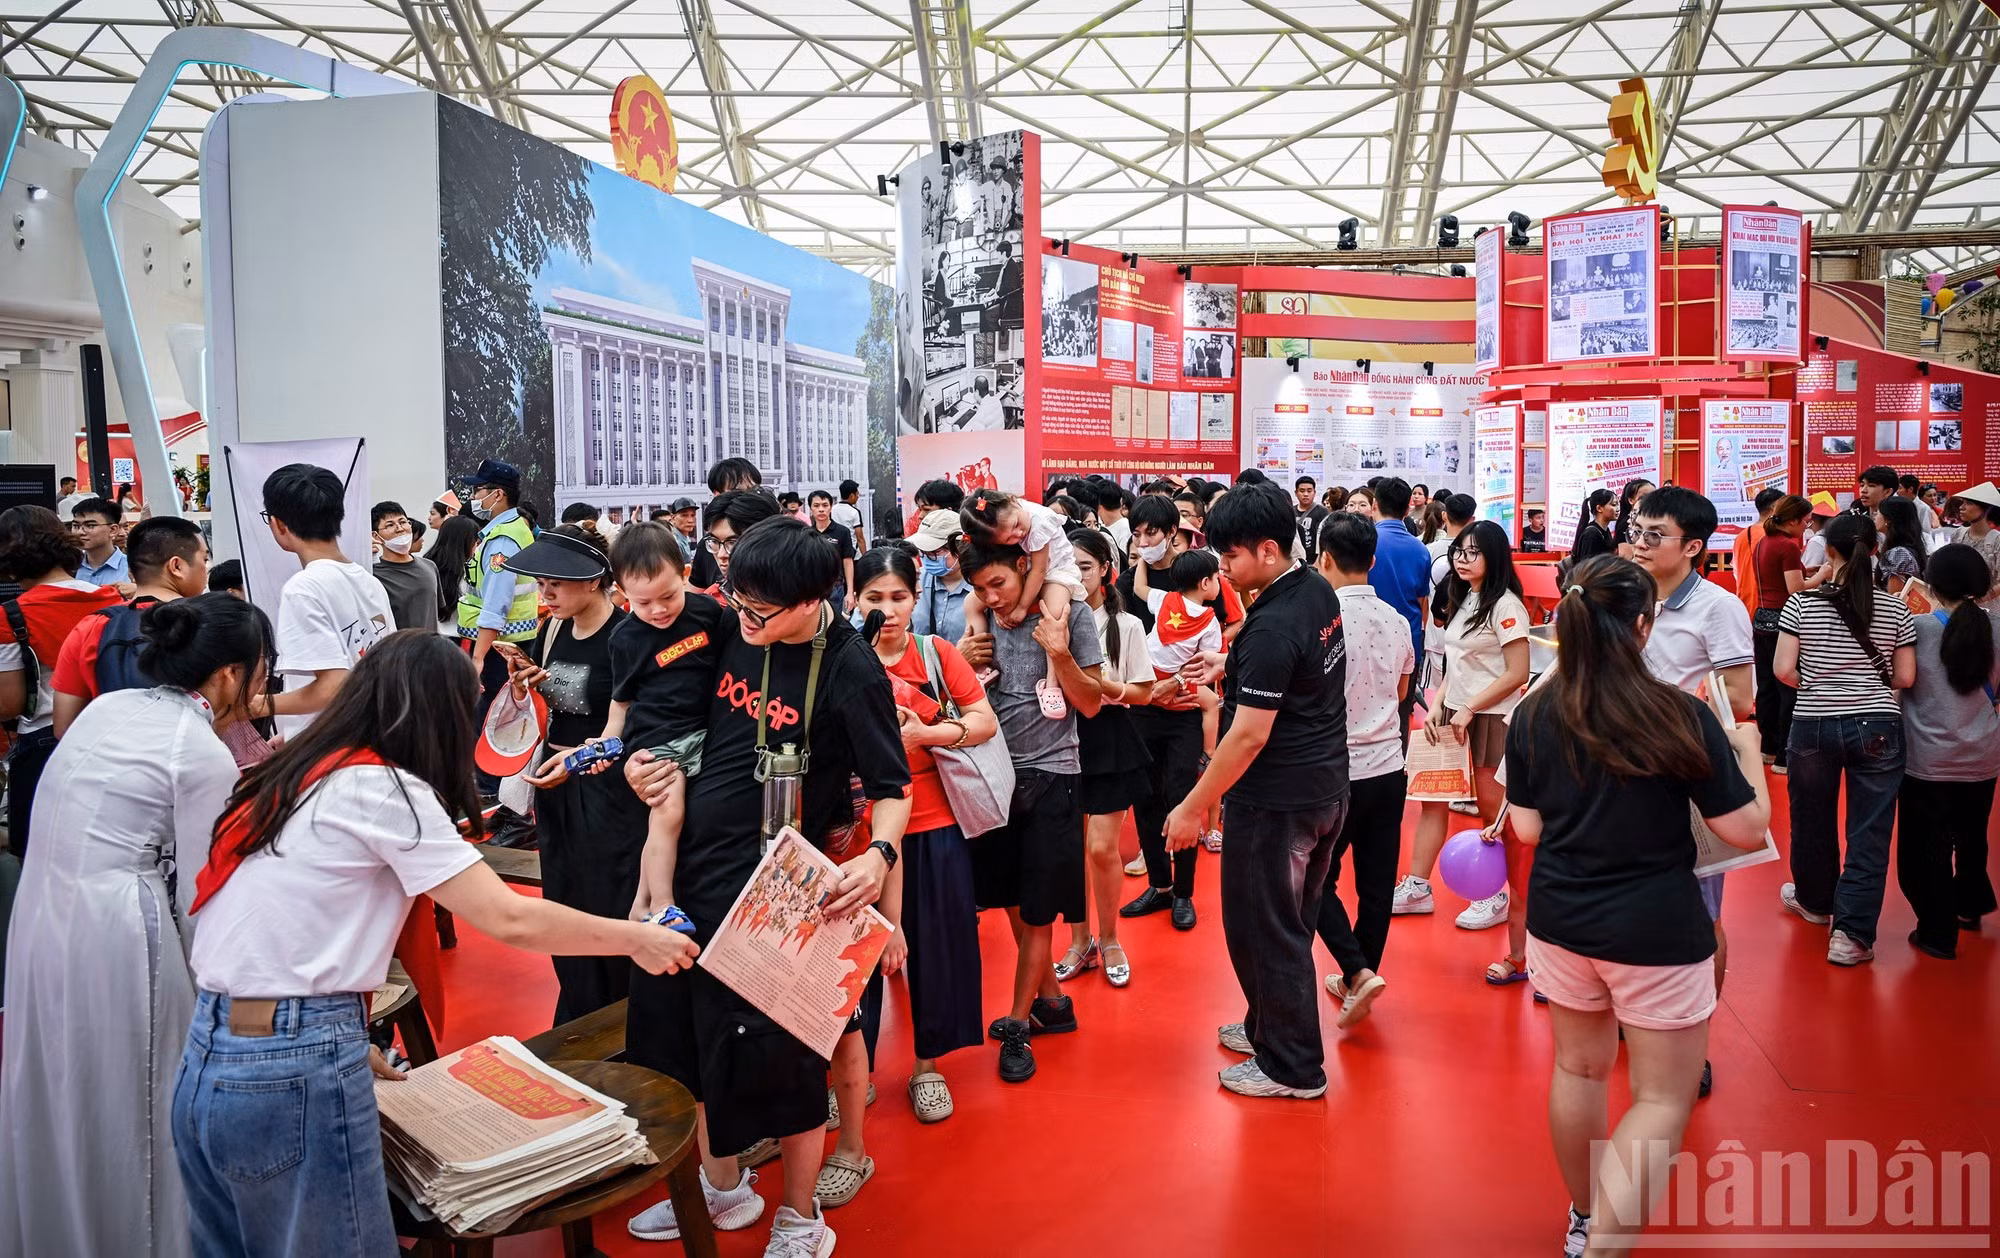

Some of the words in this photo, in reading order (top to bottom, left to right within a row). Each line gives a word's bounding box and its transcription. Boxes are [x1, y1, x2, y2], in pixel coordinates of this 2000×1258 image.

[1744, 216, 1763, 228] Nhân
[1764, 218, 1777, 228] Dân
[1314, 372, 1328, 381] Báo
[1330, 370, 1352, 382] Nhân
[1353, 372, 1369, 383] Dân
[1371, 374, 1391, 384] ĐỒNG
[1393, 374, 1413, 385] HÀNH
[1440, 374, 1456, 385] ĐẤT
[1460, 375, 1485, 385] NƯỚC
[1612, 407, 1628, 416] Dân
[1167, 461, 1176, 470] LÀM
[1177, 461, 1186, 470] BÁO
[1603, 460, 1625, 470] Nhân
[1627, 456, 1644, 466] Dân
[660, 644, 684, 663] ĐỘC
[685, 635, 704, 648] LẬP
[554, 678, 570, 687] Dior
